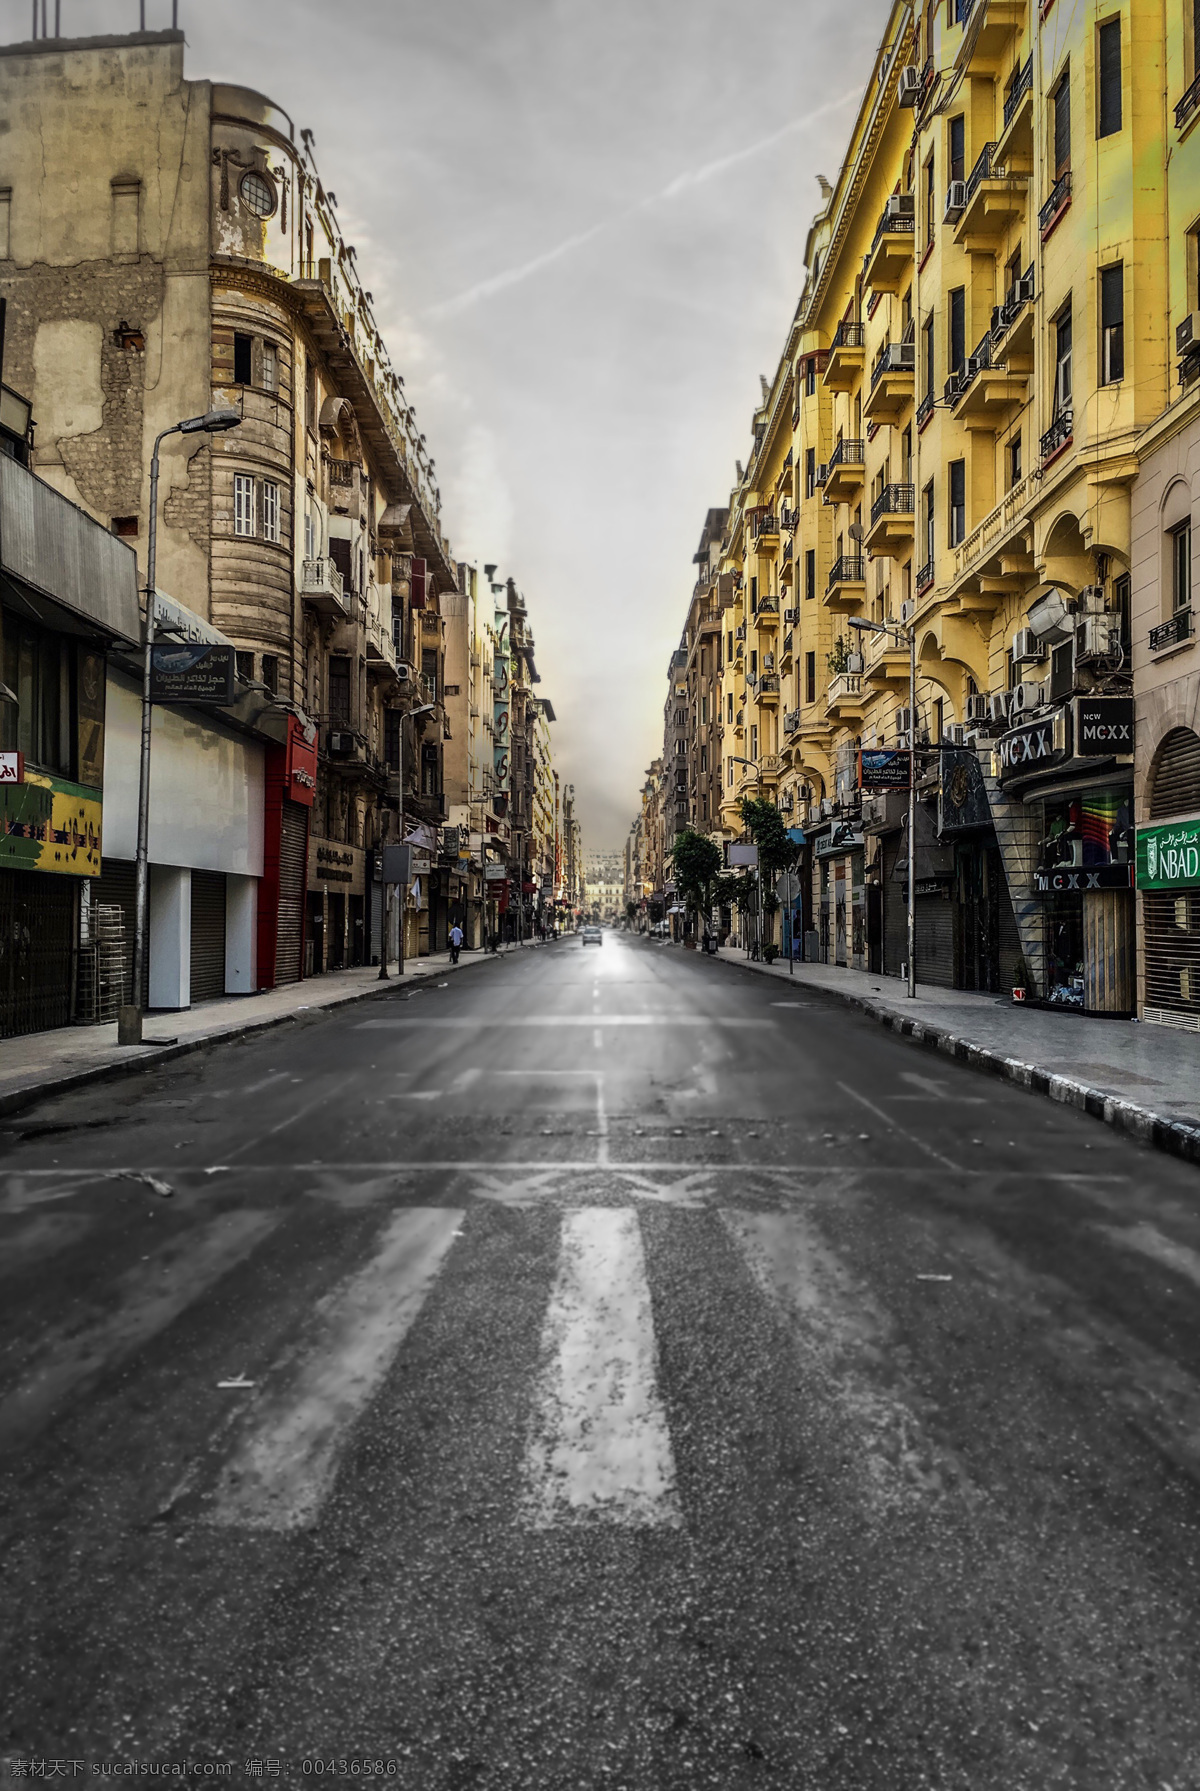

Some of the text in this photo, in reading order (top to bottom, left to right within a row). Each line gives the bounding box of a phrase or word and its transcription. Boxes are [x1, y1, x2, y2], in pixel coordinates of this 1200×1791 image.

[1083, 725, 1130, 740] MCXX
[1000, 729, 1047, 769] MCXX
[1160, 847, 1199, 880] NBAD
[1039, 872, 1100, 891] MCXX
